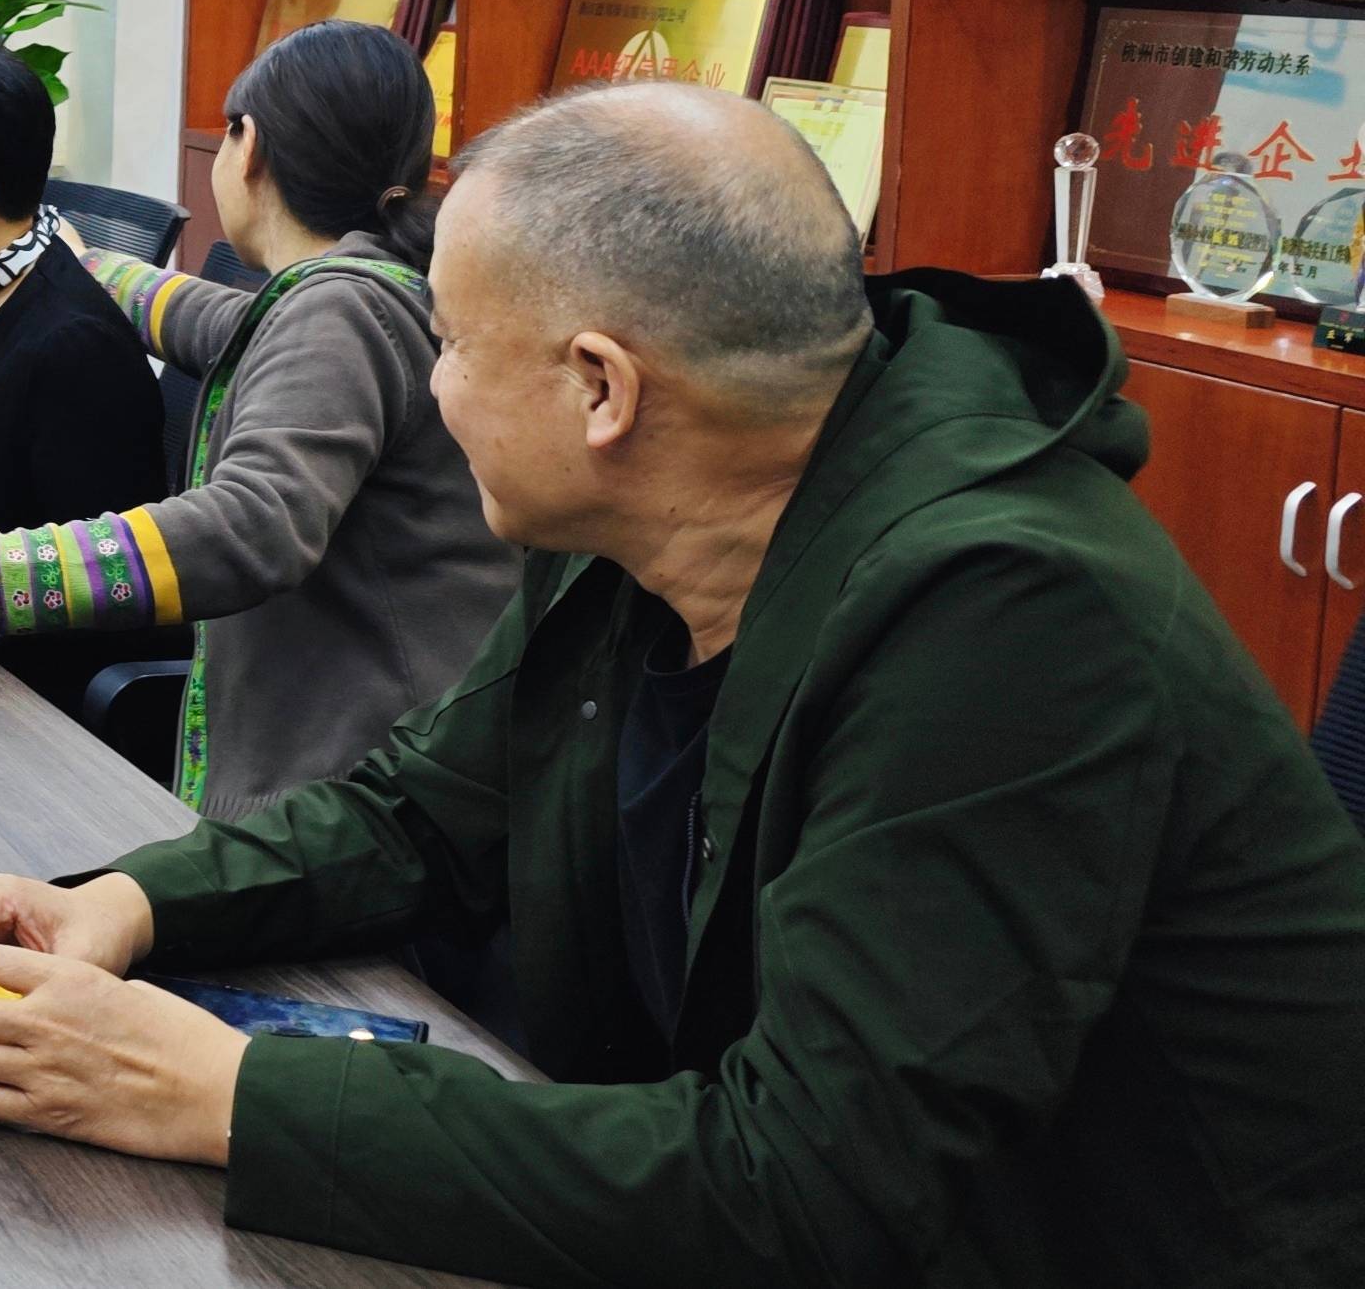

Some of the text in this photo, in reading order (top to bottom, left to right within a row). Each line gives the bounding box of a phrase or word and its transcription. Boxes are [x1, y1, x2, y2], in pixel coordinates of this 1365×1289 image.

[1121, 41, 1311, 76] 杭州市创建和谐劳动关系
